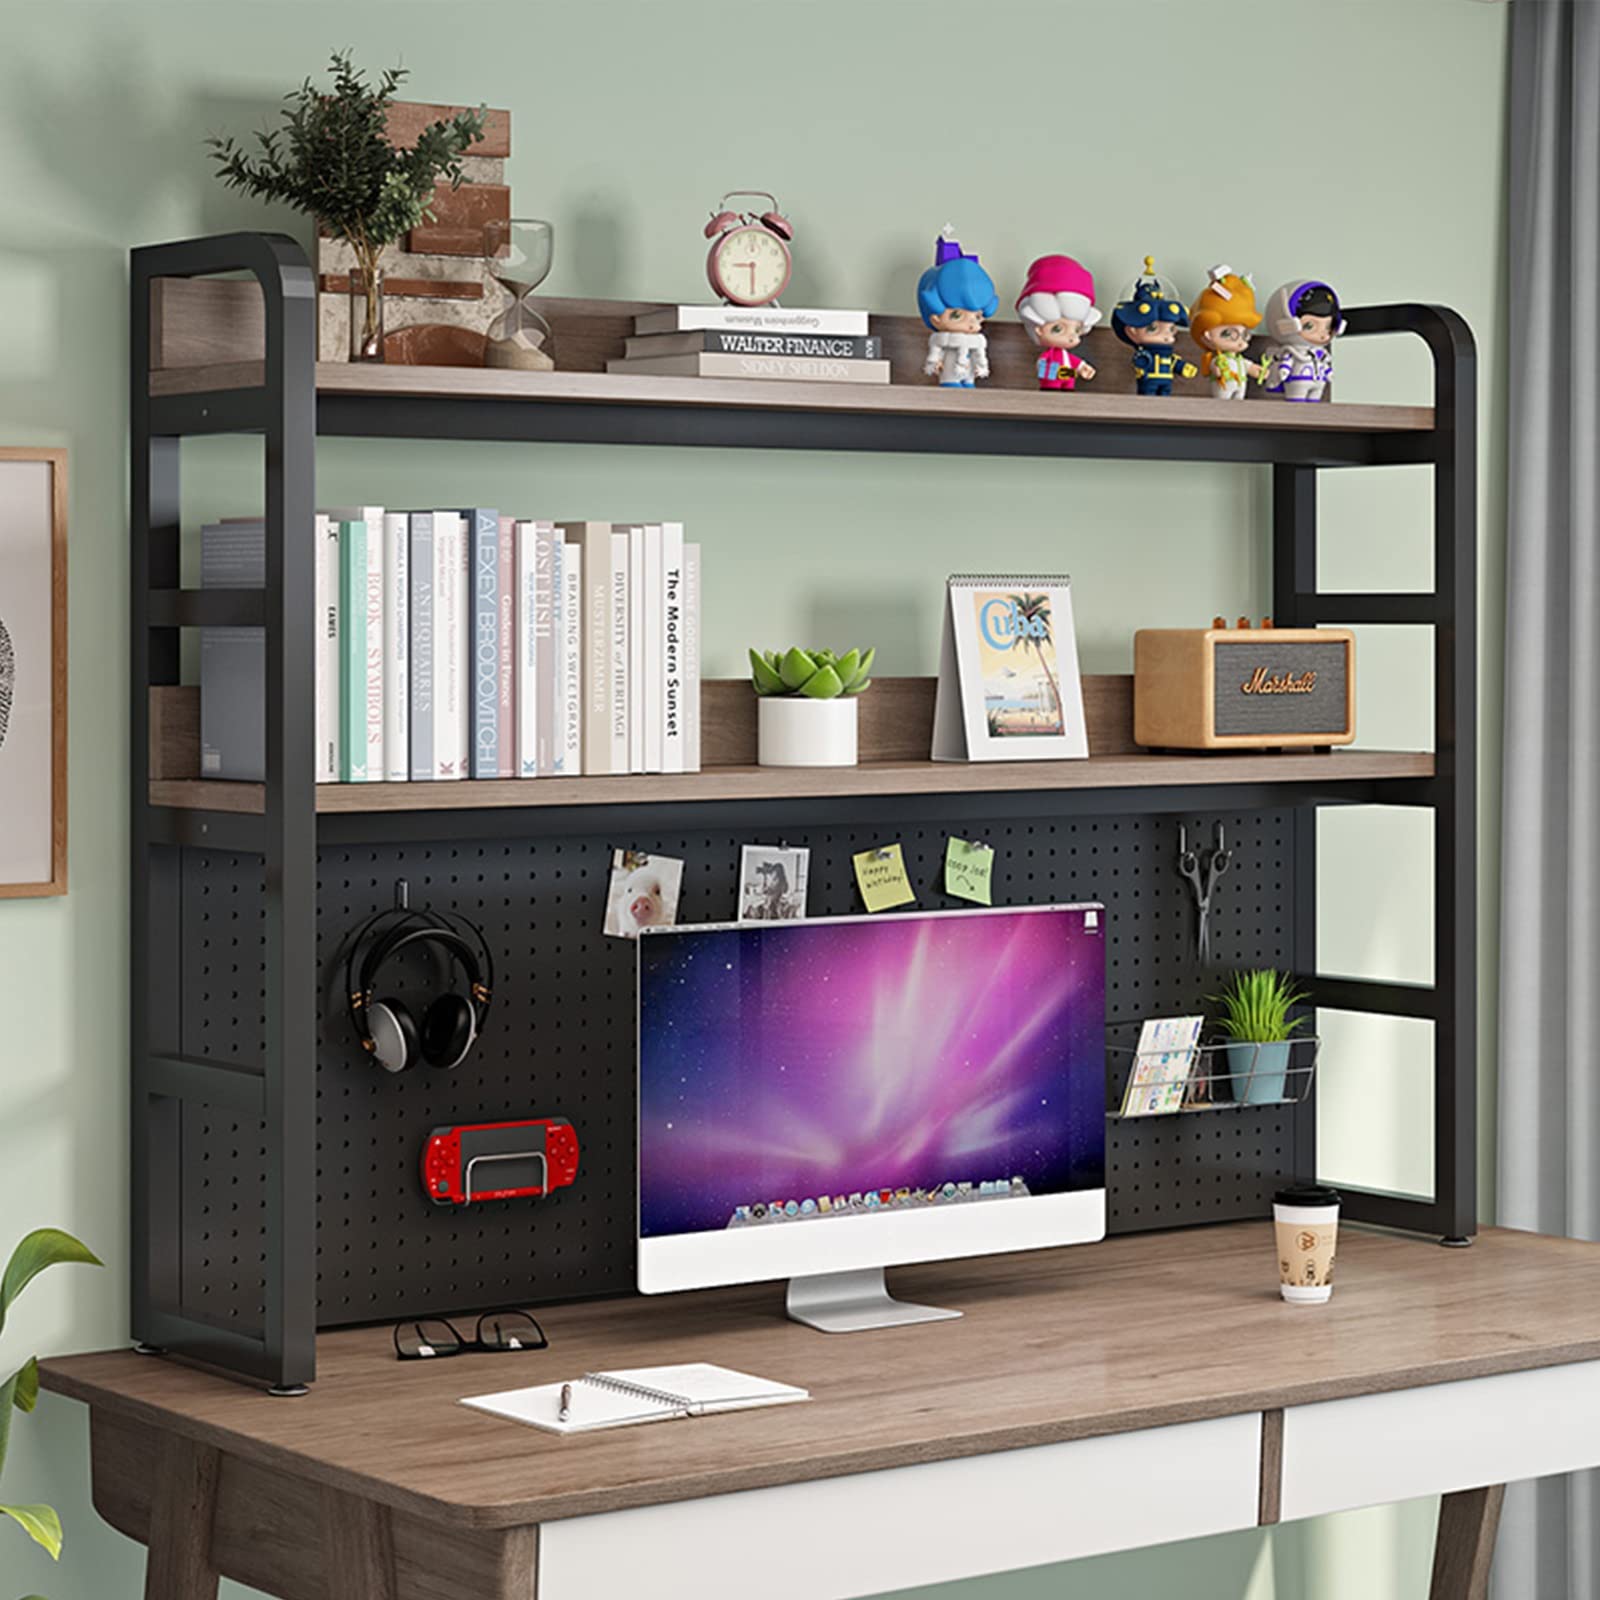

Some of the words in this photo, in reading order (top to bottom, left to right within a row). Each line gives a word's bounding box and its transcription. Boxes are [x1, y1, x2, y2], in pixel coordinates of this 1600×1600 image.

[720, 335, 785, 354] WALTER
[786, 336, 853, 357] FINANCE
[479, 515, 497, 605] ALEXEY
[536, 527, 551, 584] LOST
[667, 568, 680, 600] The
[367, 572, 382, 626] BOOK
[567, 573, 577, 645] BRAIDING
[614, 571, 625, 646] DIVERSITY
[980, 599, 1047, 651] Cuba
[417, 582, 432, 712] ANTIQUAIRES
[592, 584, 604, 713] MUSTERZIMMER
[667, 605, 680, 674] Modern
[367, 647, 382, 744] SYMBOLS
[479, 611, 497, 761] BRODOVITCH
[567, 651, 577, 750] SWEETGRASS
[614, 668, 625, 739] HERITAGE
[667, 678, 680, 738] Sunset
[1241, 667, 1317, 695] Marshall
